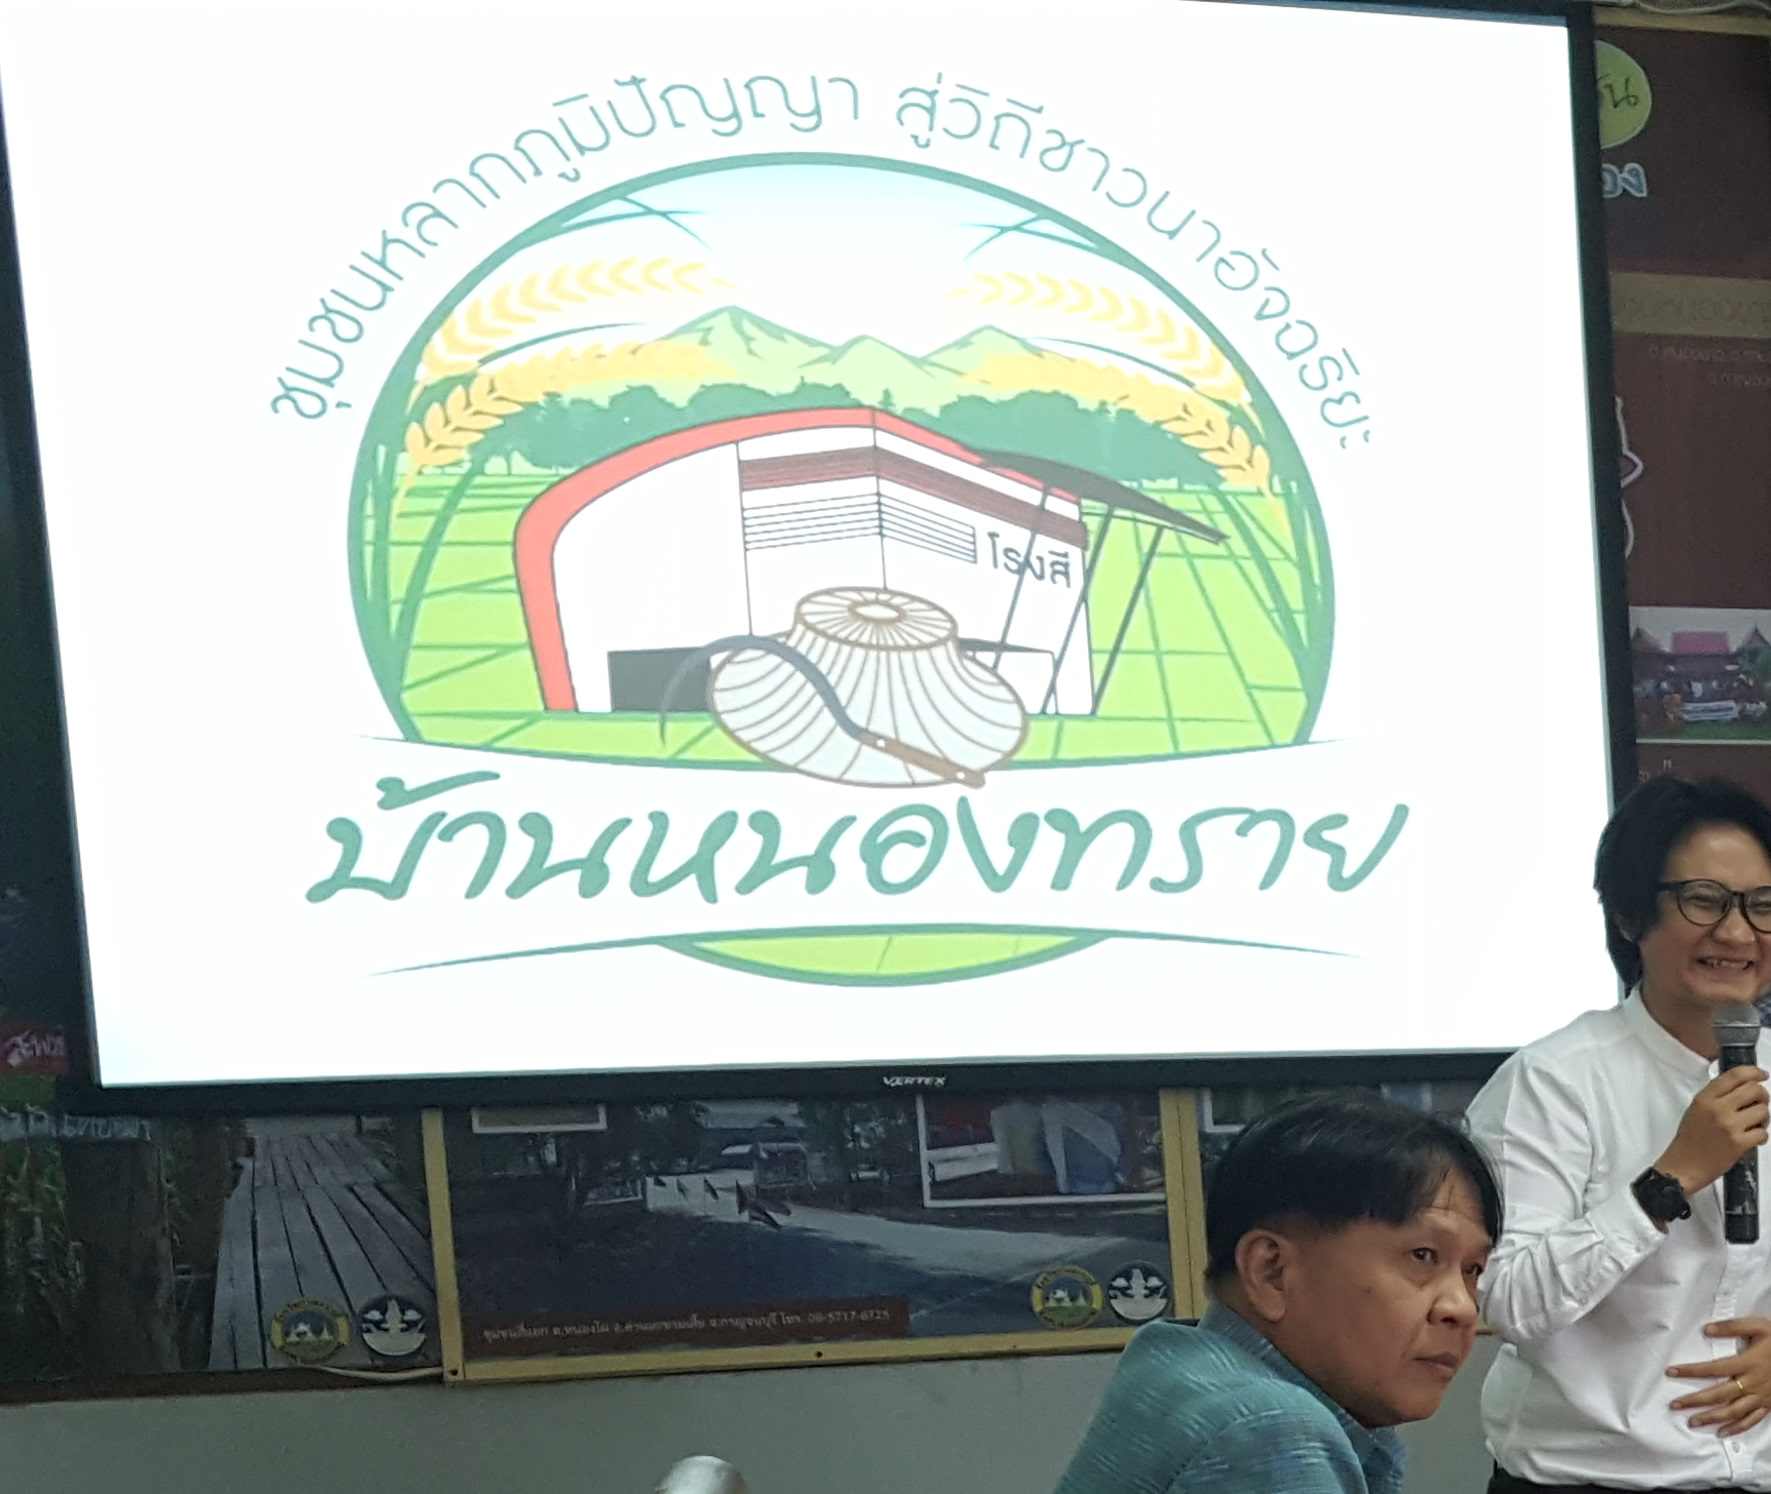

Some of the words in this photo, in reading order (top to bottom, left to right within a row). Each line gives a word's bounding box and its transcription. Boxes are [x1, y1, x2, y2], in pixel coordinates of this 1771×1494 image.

[270, 74, 858, 420] ชุมชนหลากภูมิปัญญา
[896, 72, 1371, 449] สู่วิถีชาวนาอัจฉริยะ
[988, 531, 1071, 588] โรงสี
[305, 770, 1408, 906] บ้านหนองทราย
